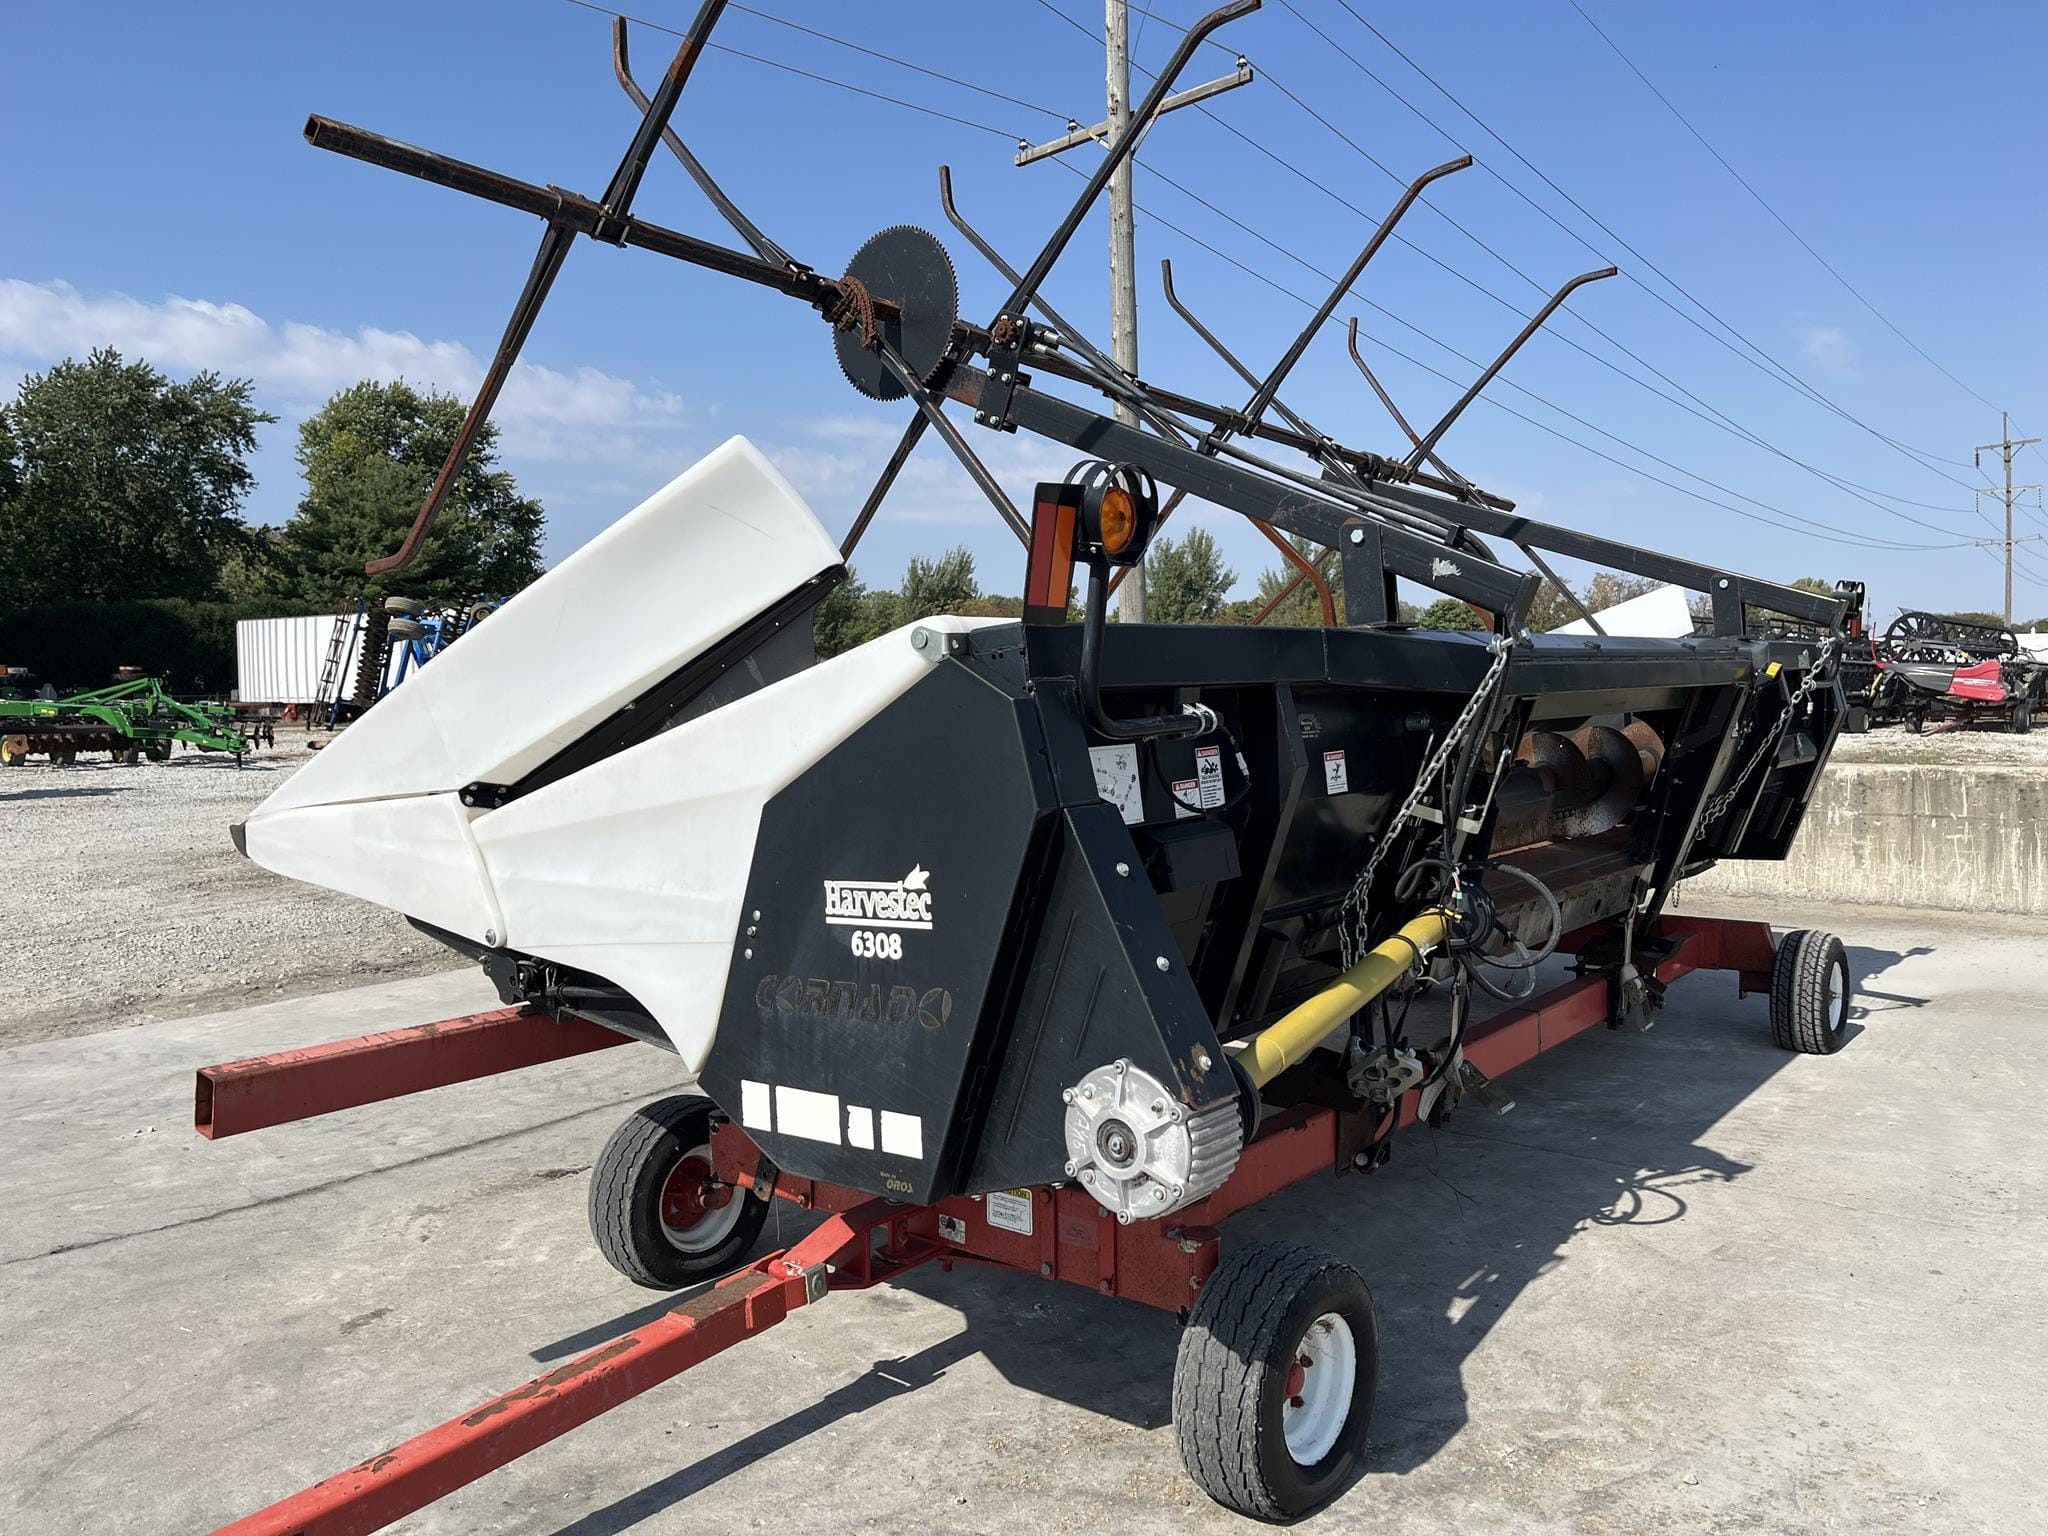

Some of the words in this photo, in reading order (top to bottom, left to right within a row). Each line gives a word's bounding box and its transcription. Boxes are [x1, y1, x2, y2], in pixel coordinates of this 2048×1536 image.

[824, 880, 932, 921] Harvestec
[851, 930, 903, 960] 6308
[756, 974, 953, 1029] CORNADO
